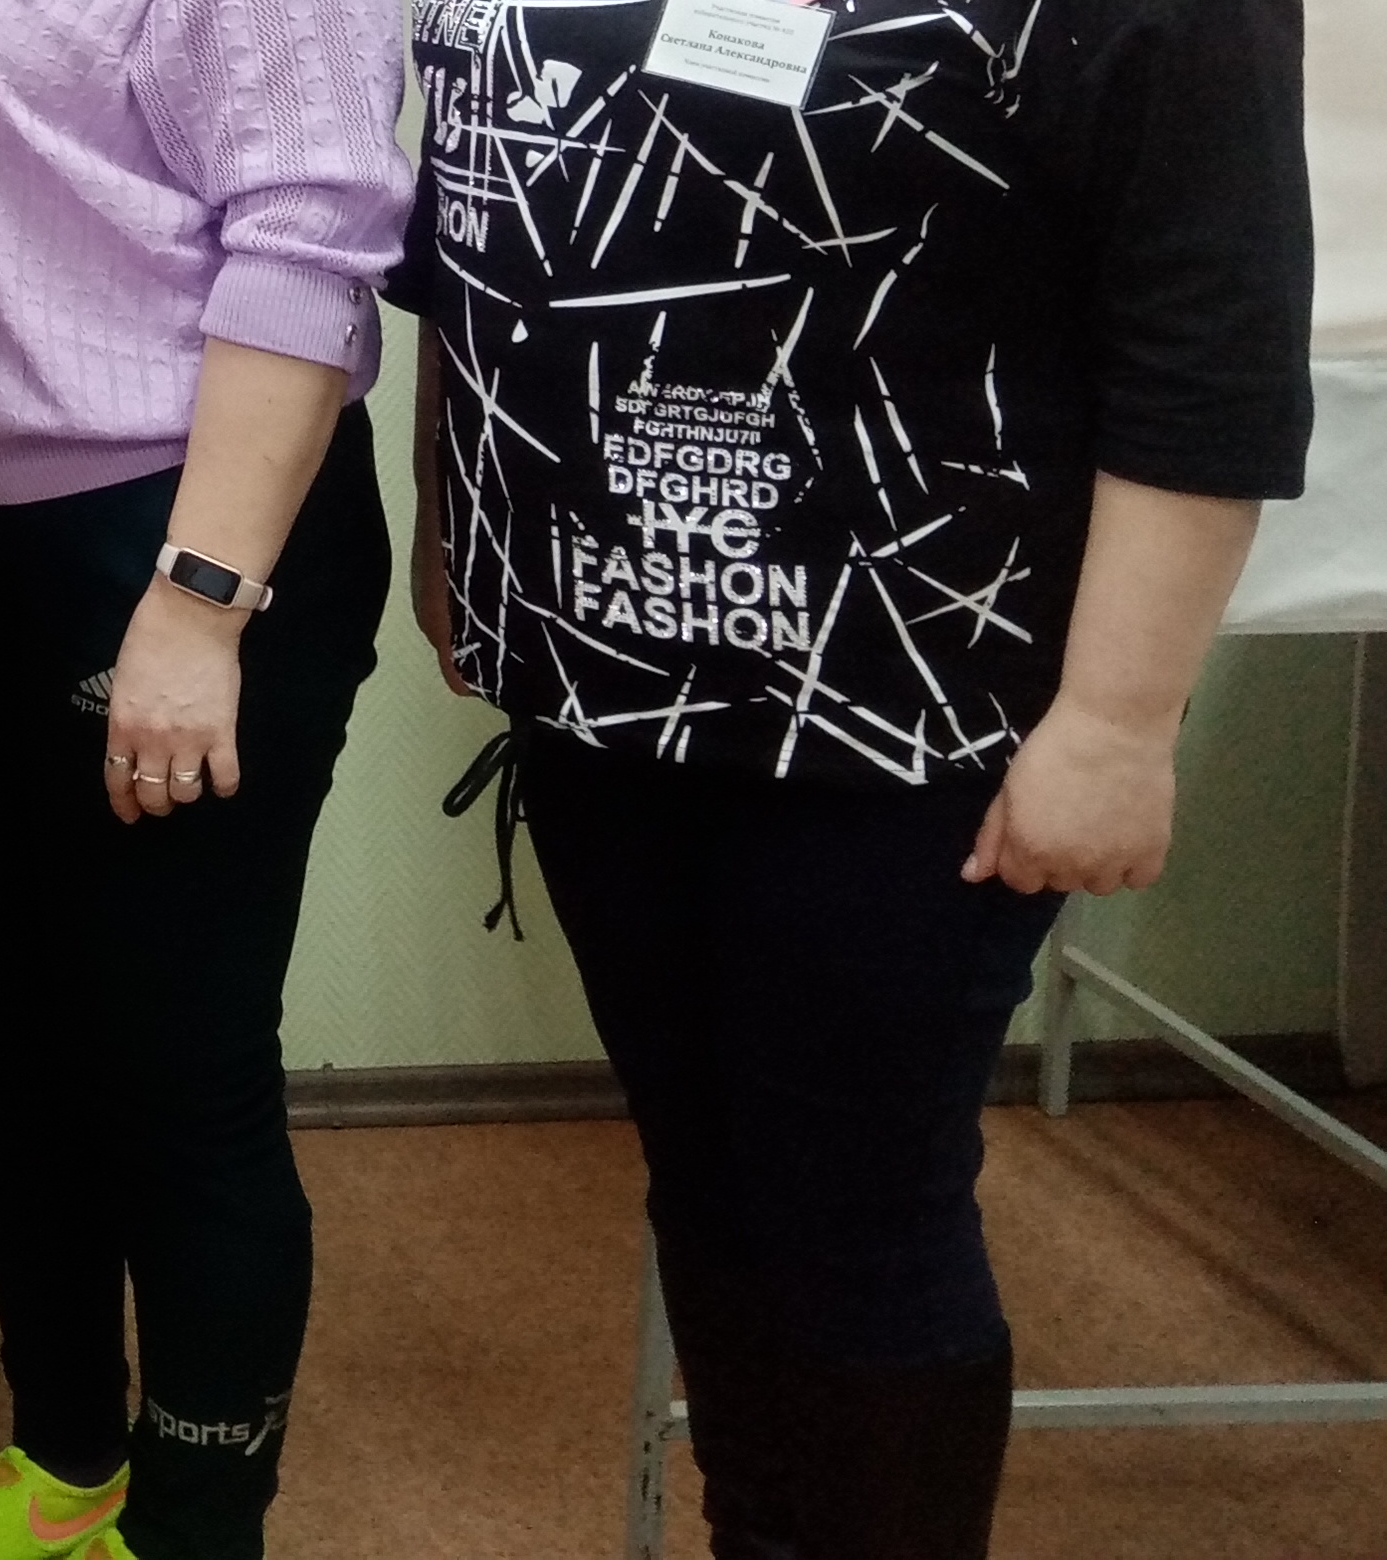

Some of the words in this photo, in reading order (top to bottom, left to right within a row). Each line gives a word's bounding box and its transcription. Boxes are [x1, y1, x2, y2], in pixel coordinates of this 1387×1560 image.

[660, 33, 713, 53] Светлана
[714, 44, 807, 74] Александровна
[708, 29, 765, 50] Конакова
[603, 433, 792, 481] EDFGDRG
[608, 464, 779, 509] DFGHRD
[572, 534, 808, 607] FASHON
[574, 579, 811, 651] FASHON
